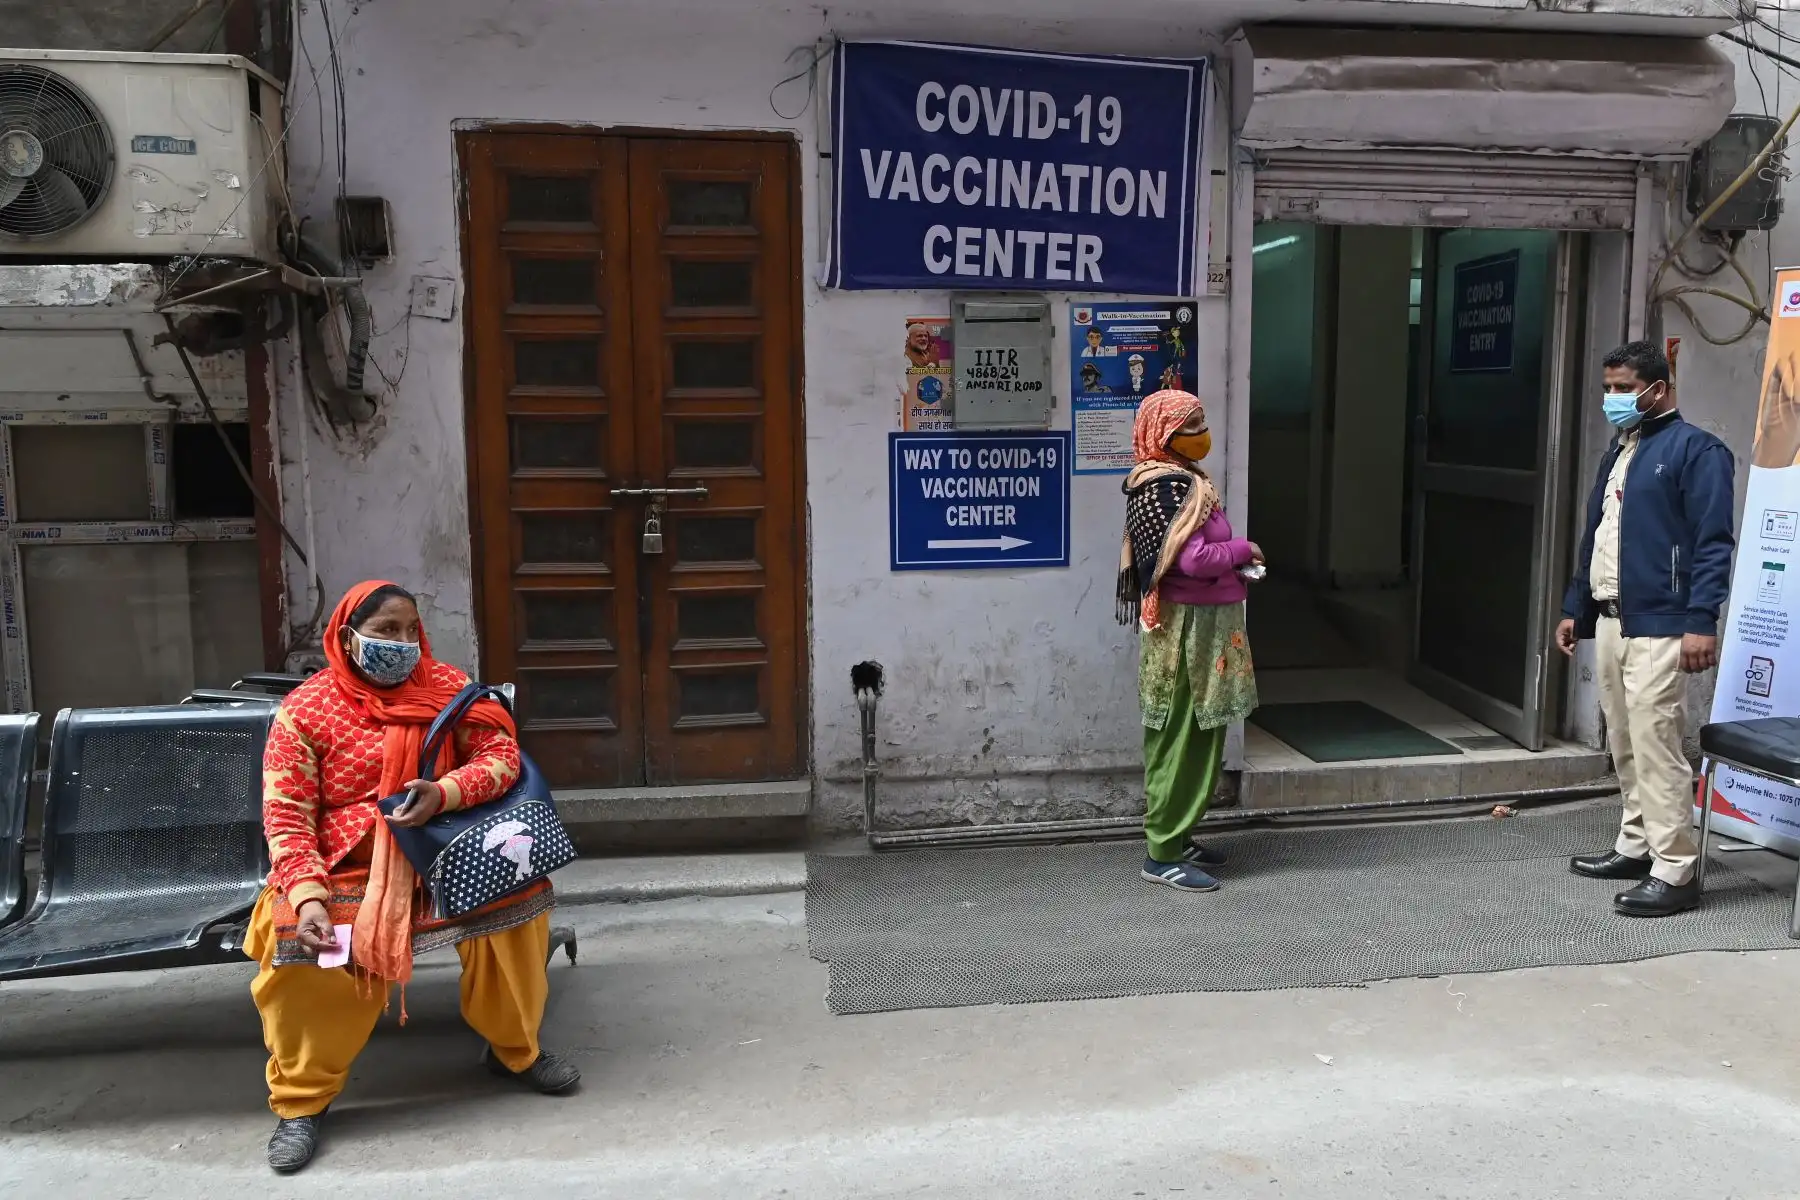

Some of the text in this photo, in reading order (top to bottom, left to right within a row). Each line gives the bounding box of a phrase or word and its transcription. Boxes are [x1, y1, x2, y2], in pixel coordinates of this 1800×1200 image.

[916, 81, 1122, 146] COVID-19
[160, 140, 193, 152] COOL
[860, 149, 1166, 218] VACCINATION
[923, 224, 1104, 282] CENTER
[1467, 280, 1504, 303] COVID-19
[1458, 304, 1511, 330] VACCINATION
[1470, 332, 1496, 352] ENTRY
[1015, 381, 1042, 392] ROAD
[904, 448, 1057, 470] WAY TO COVID-19
[921, 476, 1040, 498] VACCINATION
[946, 505, 1016, 526] CENTER
[1760, 608, 1776, 616] Identity
[1743, 622, 1765, 630] employees
[1758, 639, 1780, 647] Companies
[1736, 696, 1772, 709] Pension document
[1746, 707, 1769, 717] photograph
[1736, 781, 1761, 796] Helpline
[1779, 793, 1793, 803] 1075
